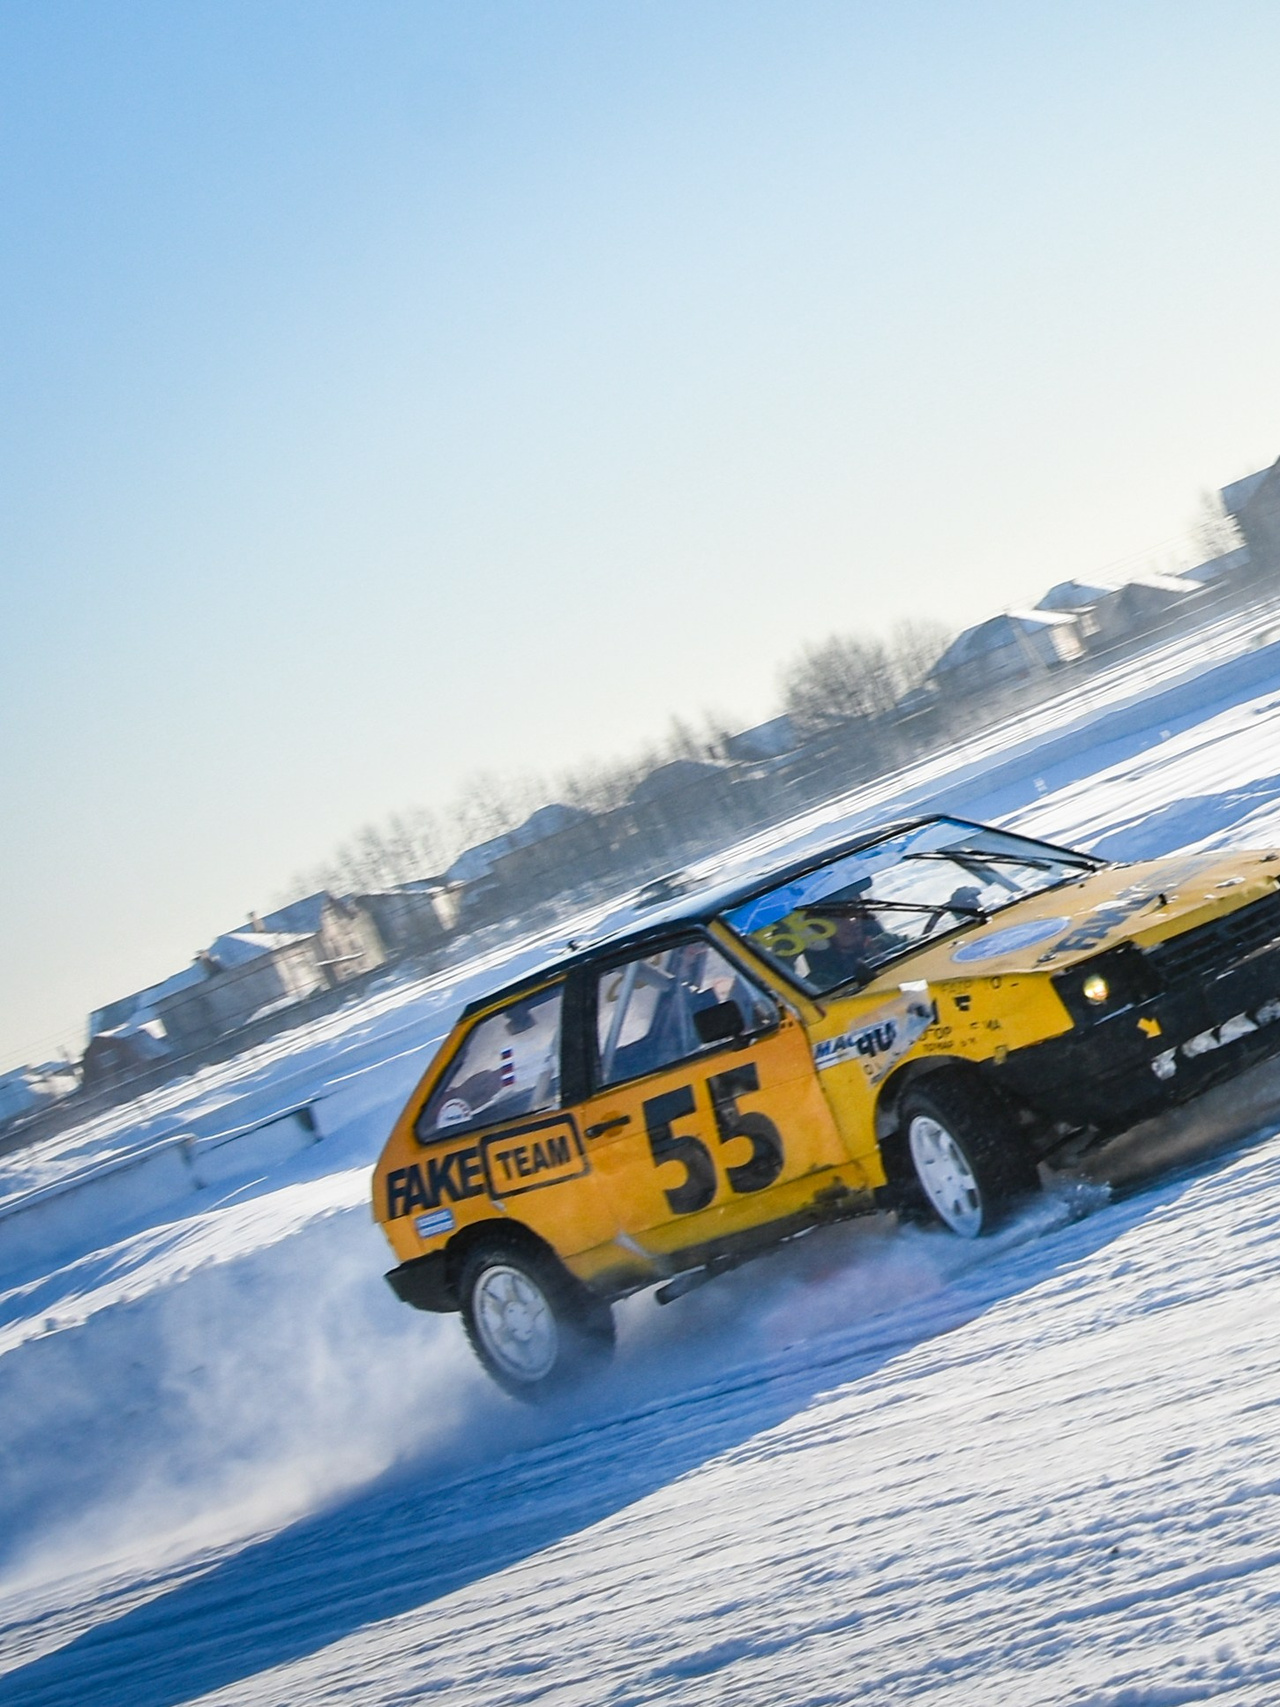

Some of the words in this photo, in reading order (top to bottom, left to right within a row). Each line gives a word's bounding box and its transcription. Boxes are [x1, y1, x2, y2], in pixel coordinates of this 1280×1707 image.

[387, 1146, 485, 1219] FAKE
[495, 1136, 570, 1180] TEAM
[643, 1063, 784, 1214] 55
